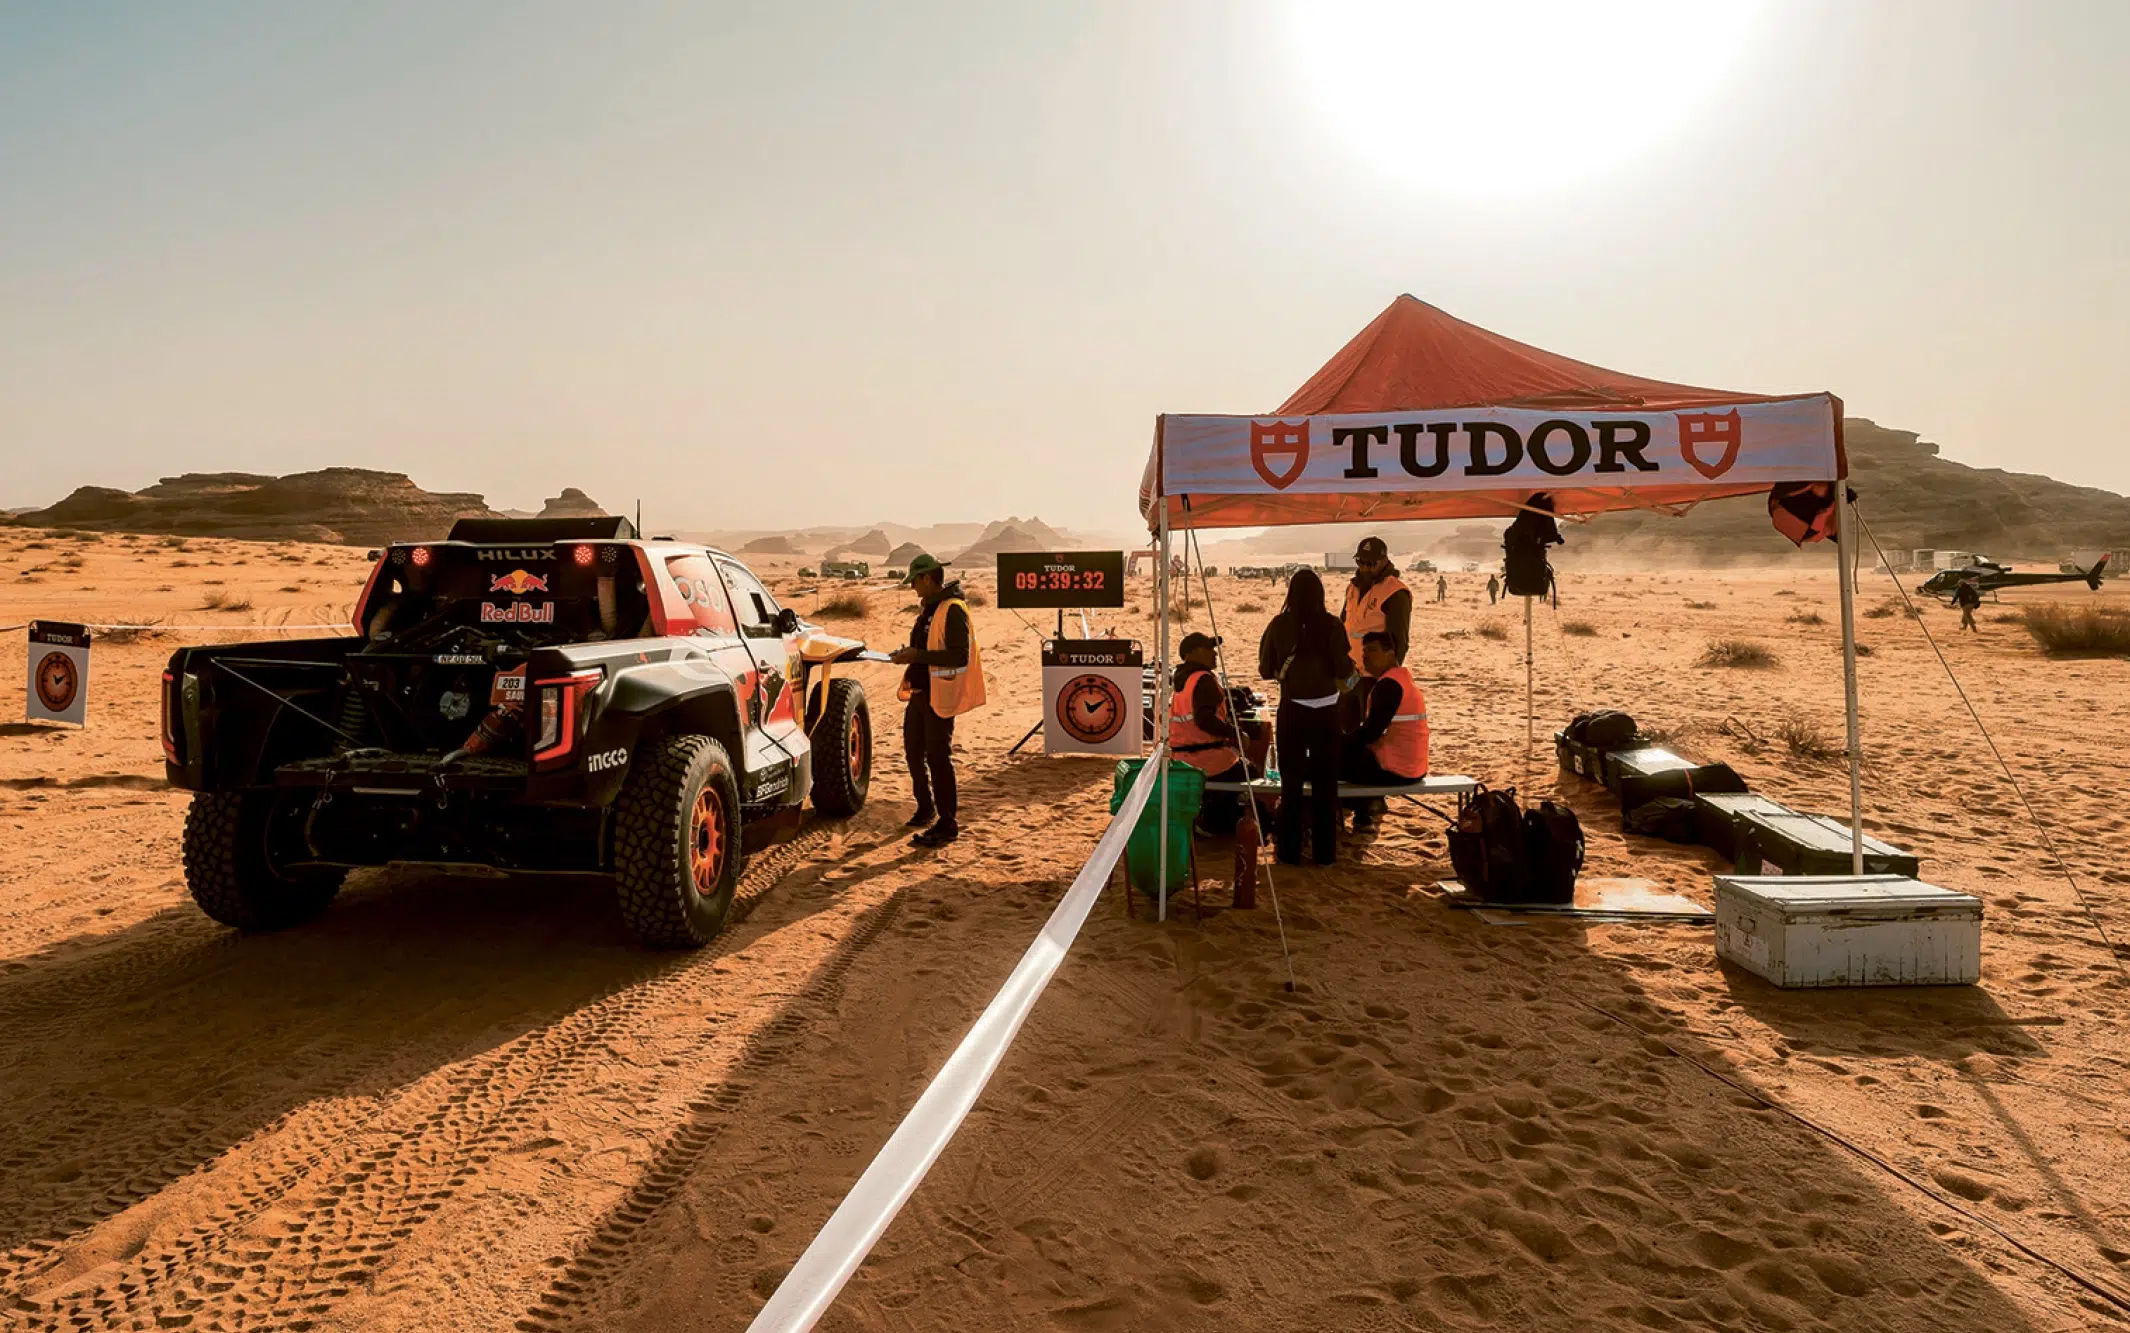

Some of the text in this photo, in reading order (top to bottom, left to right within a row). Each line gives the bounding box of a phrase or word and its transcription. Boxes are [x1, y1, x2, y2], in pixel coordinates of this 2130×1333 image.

[1332, 419, 1660, 479] TUDOR
[477, 550, 557, 560] HILUX
[1016, 571, 1105, 589] 09:39:32
[481, 602, 554, 622] Red Bull
[46, 634, 73, 644] TUDOR
[1070, 653, 1115, 664] TUDOR
[502, 678, 520, 688] 203
